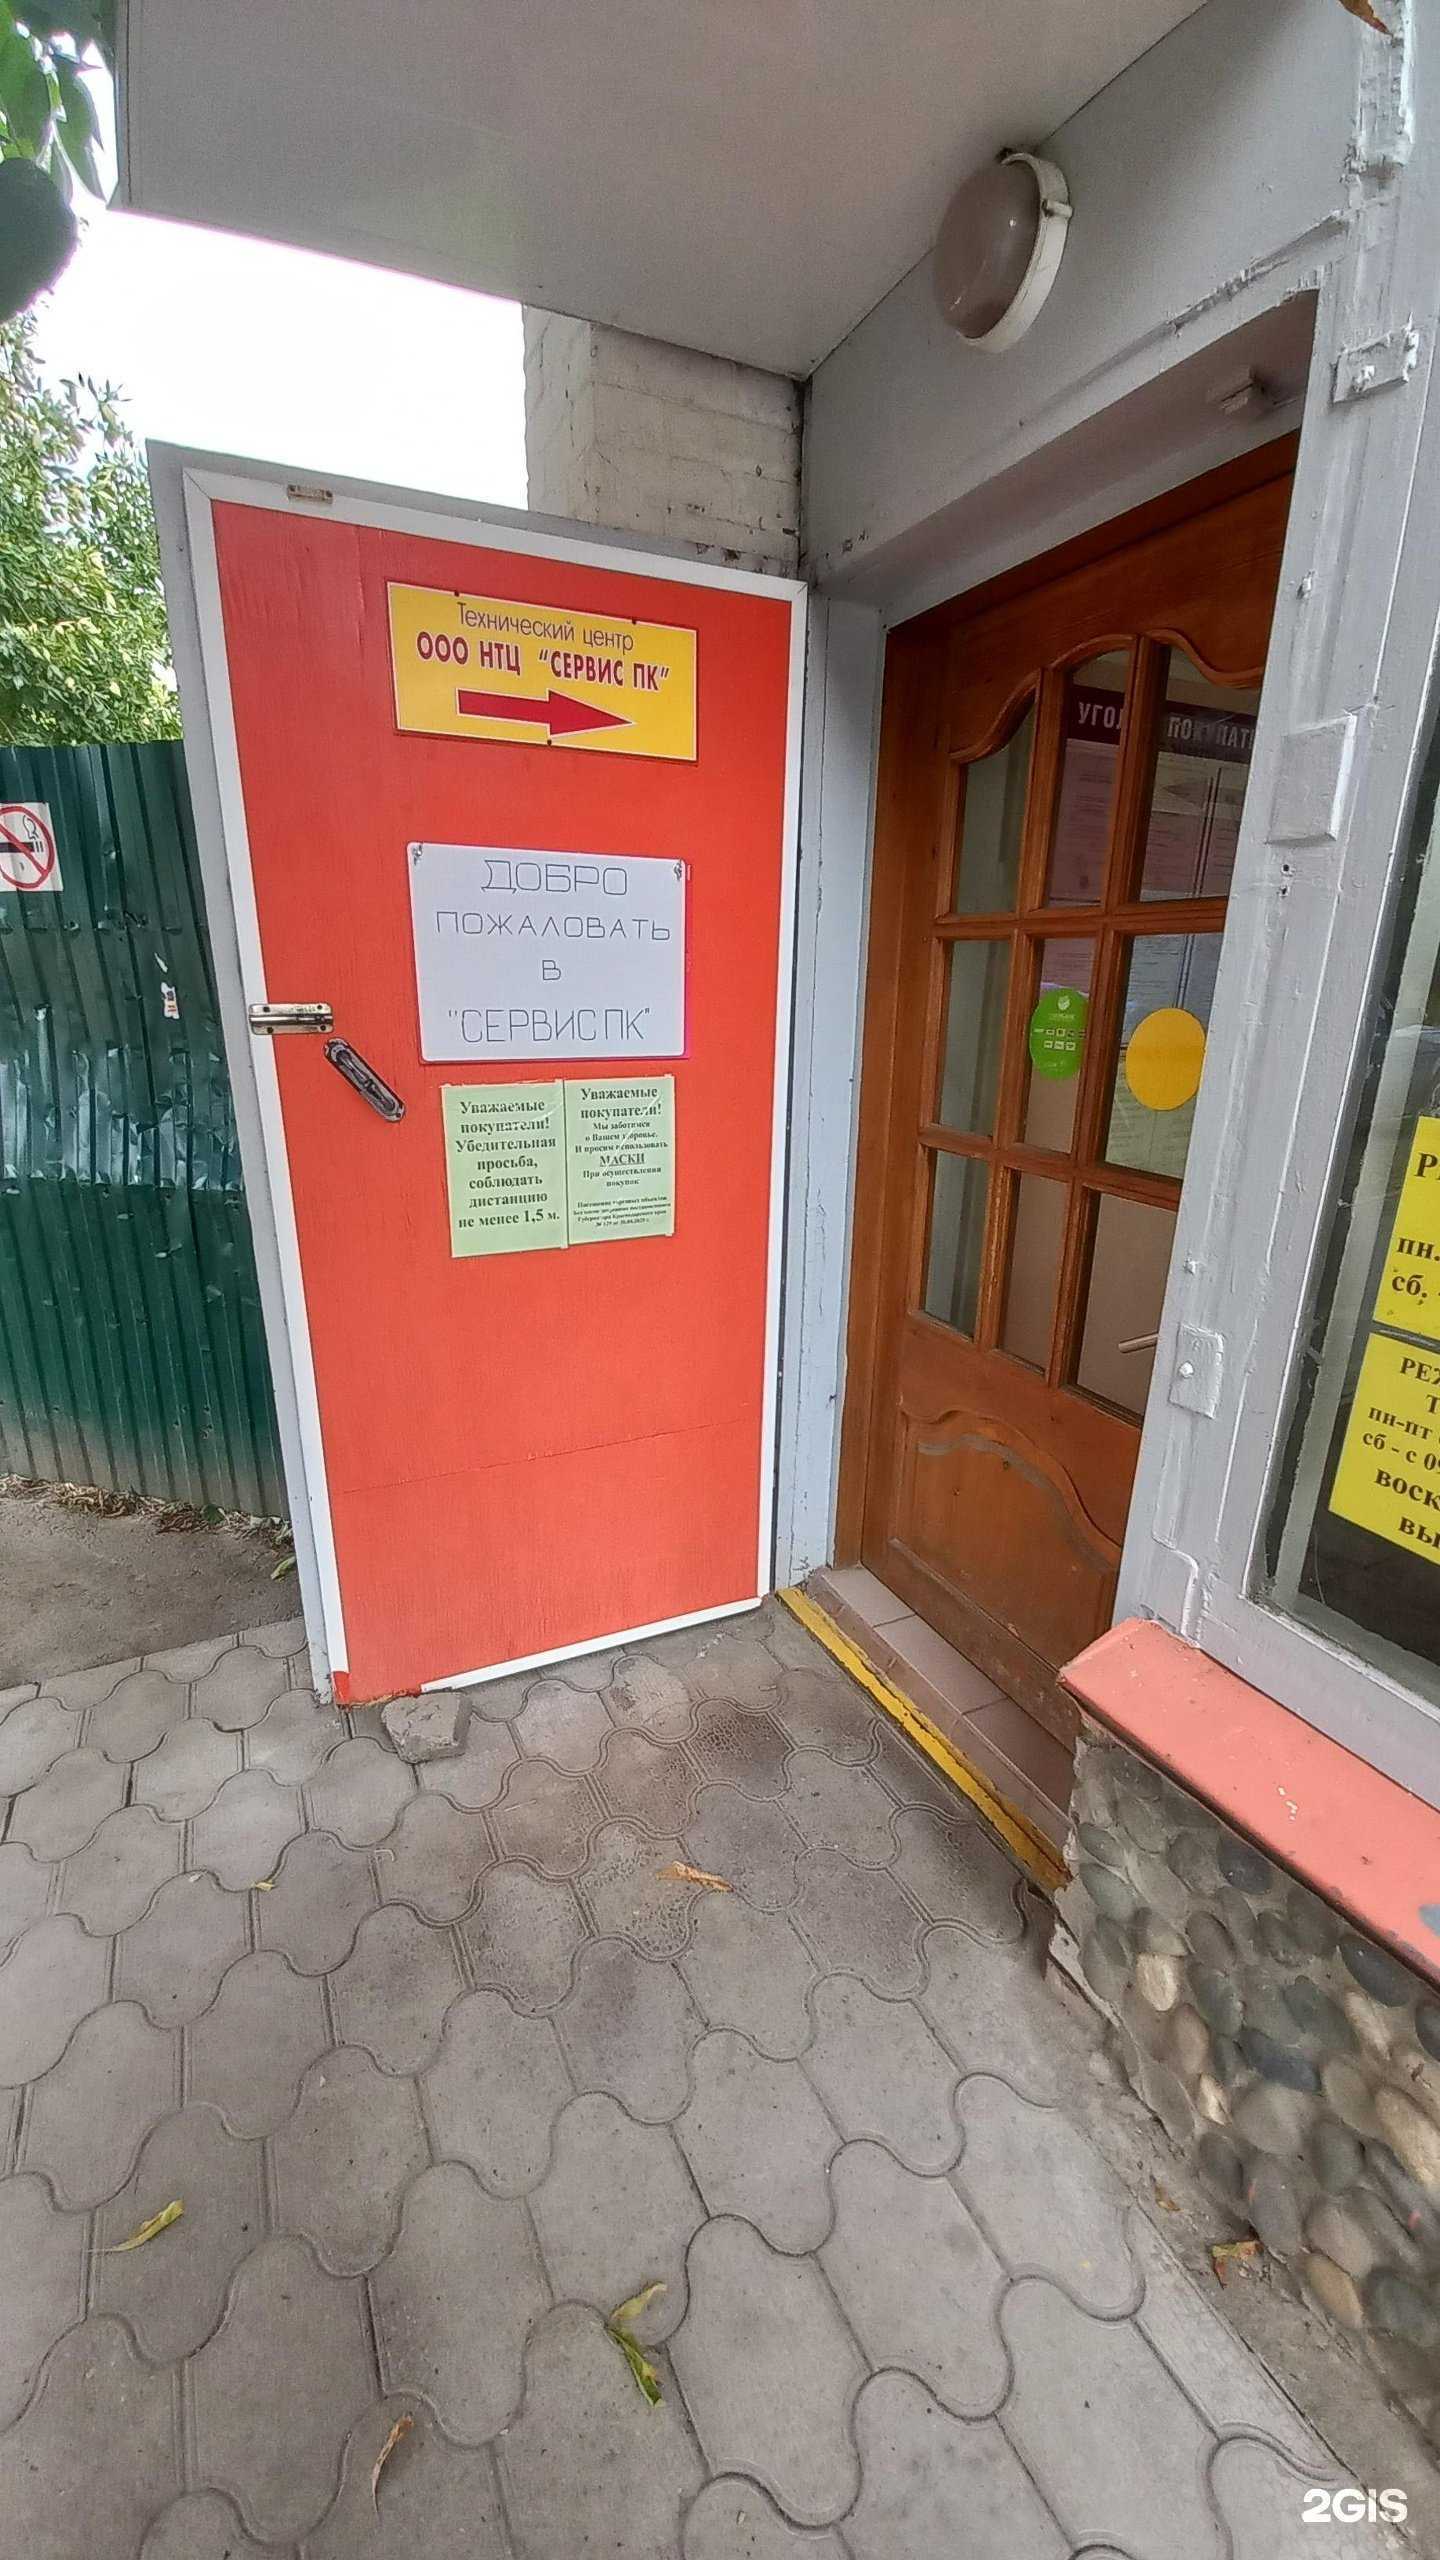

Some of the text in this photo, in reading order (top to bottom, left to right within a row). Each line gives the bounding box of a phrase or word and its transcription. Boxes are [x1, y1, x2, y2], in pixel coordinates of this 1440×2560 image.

[457, 601, 634, 655] Технический центр
[416, 631, 669, 691] ООО НТЦ "СЕРВИС ПК"
[481, 859, 628, 895] ДОБРО
[436, 911, 671, 941] ПОЖАЛОВАТЬ
[542, 959, 562, 981] В
[448, 1007, 650, 1043] "СЕРВИС ПК"
[580, 1087, 658, 1101] Уважаемые
[460, 1100, 545, 1115] Уважаемые
[461, 1116, 550, 1136] покупатели!
[593, 1122, 609, 1130] Мы
[456, 1138, 556, 1153] Убедительная
[477, 1155, 538, 1173] просьба,
[599, 1152, 645, 1167] МАСКИ
[469, 1175, 543, 1190] соблюдать
[469, 1193, 548, 1209] дистанцию
[458, 1218, 475, 1228] не
[480, 1214, 519, 1226] менее
[524, 1208, 544, 1224] 1,5
[1391, 1274, 1428, 1298] сб.
[1367, 1407, 1433, 1440] пн-пт
[1362, 1432, 1387, 1450] сб
